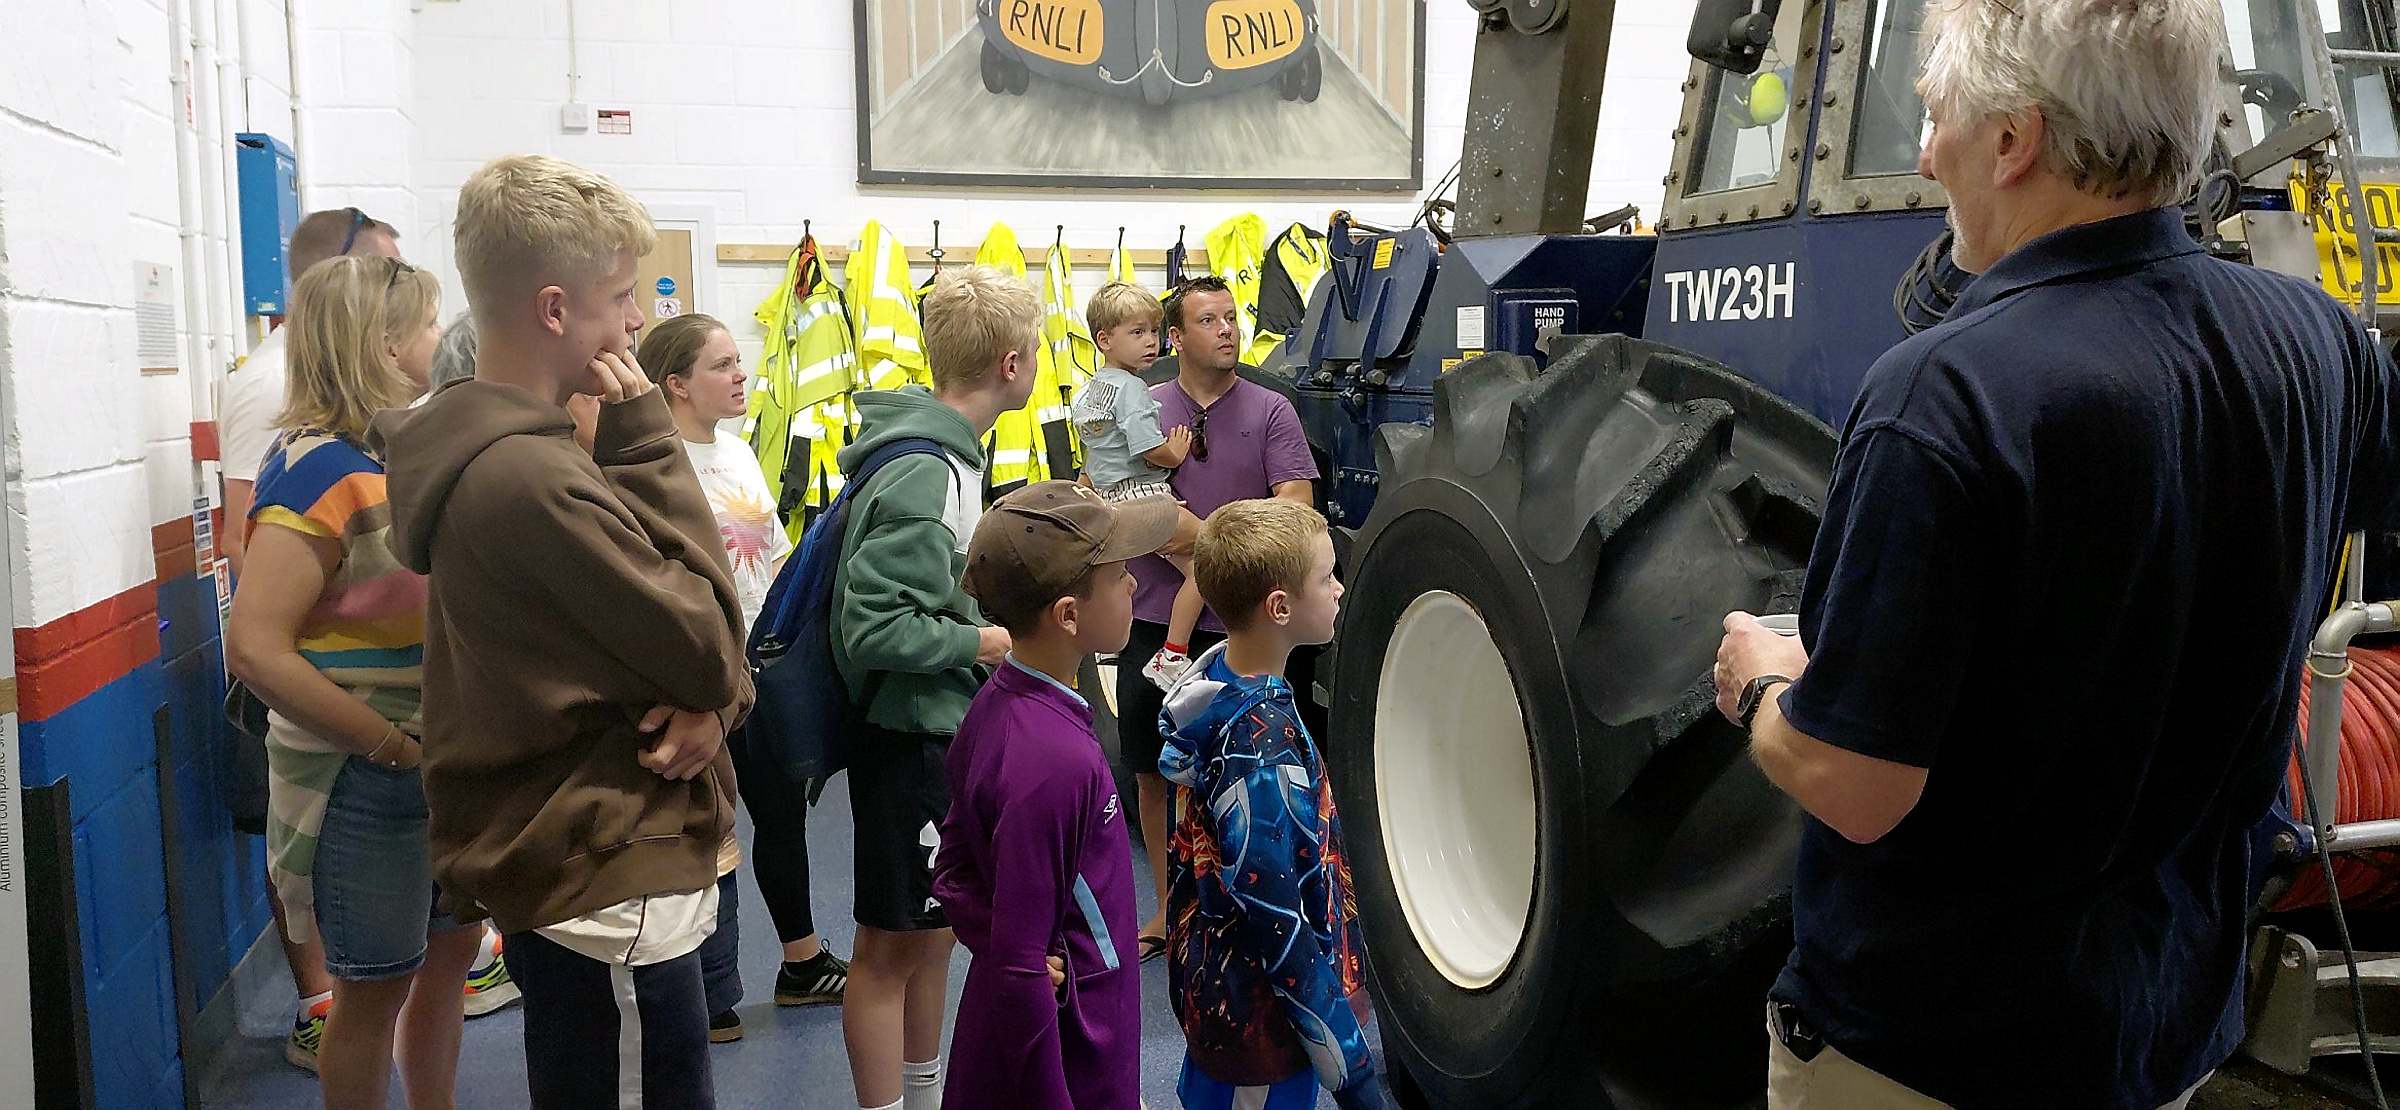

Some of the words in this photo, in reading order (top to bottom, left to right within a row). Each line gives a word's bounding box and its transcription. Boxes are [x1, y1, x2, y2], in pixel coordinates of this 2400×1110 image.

[1009, 0, 1086, 53] RNLI
[1221, 9, 1294, 59] RNLI
[1534, 307, 1565, 318] HAND
[1664, 261, 1796, 323] TW23H
[1534, 318, 1565, 329] PUMP
